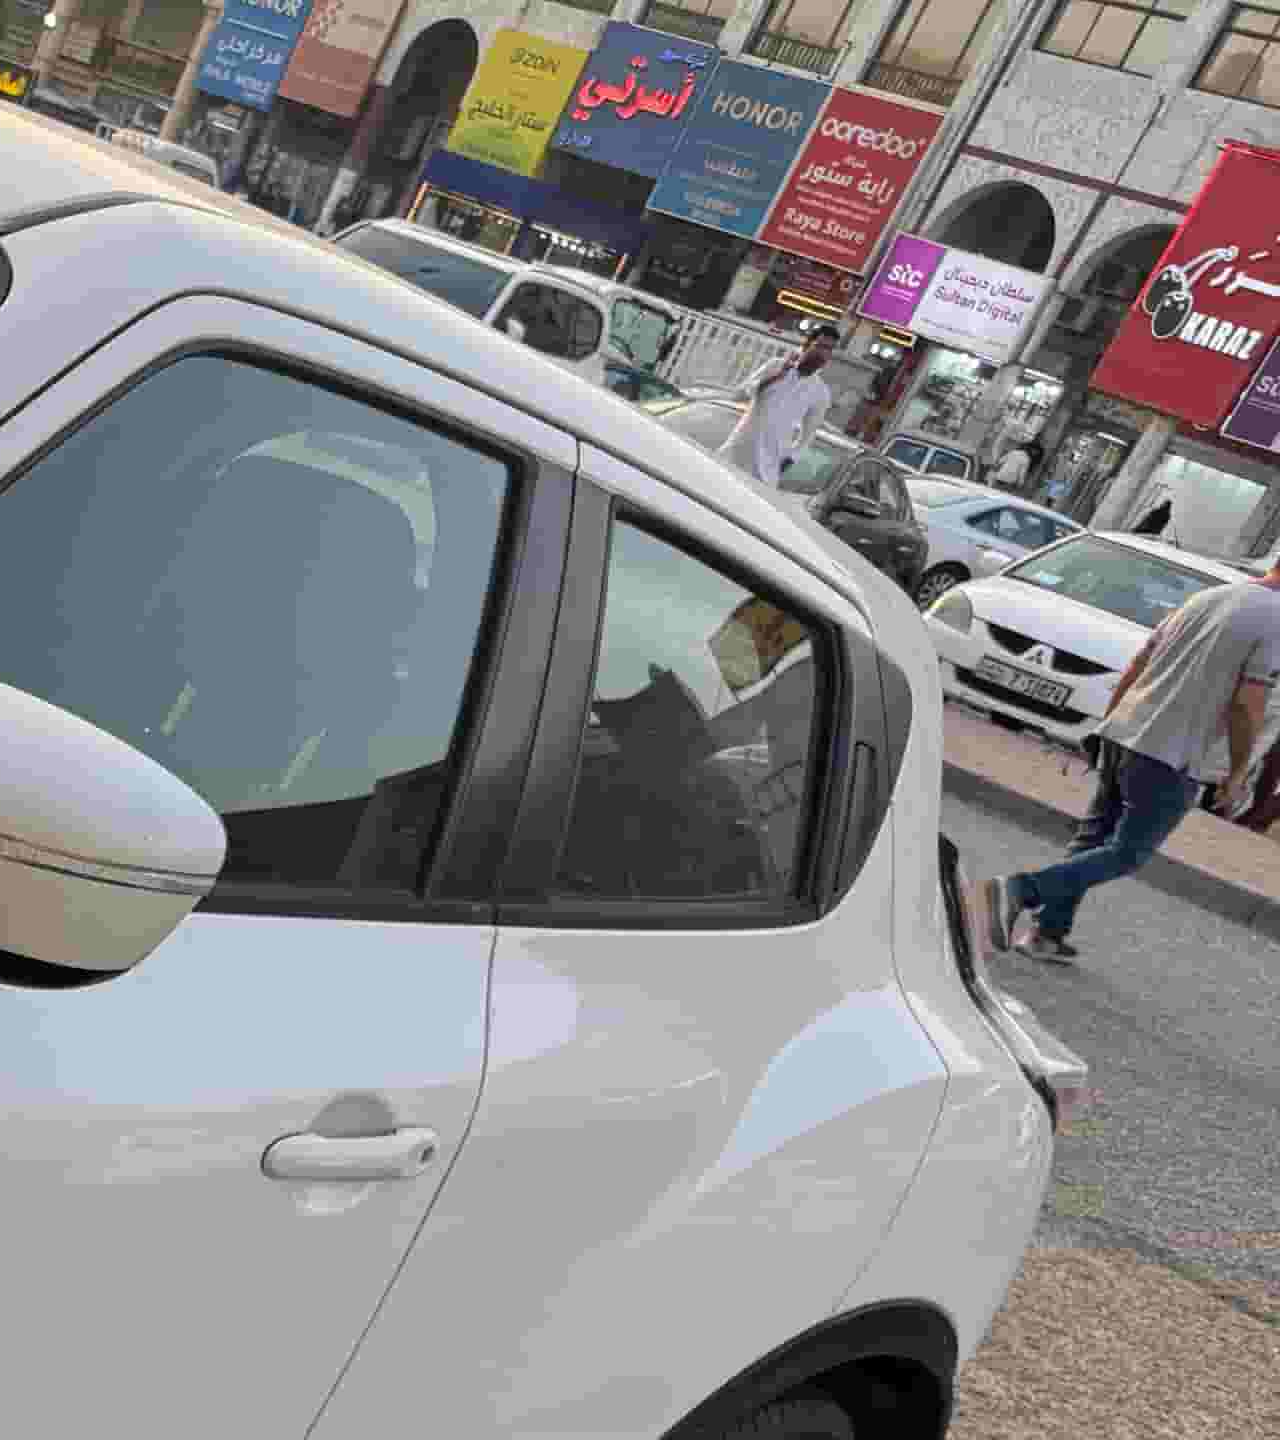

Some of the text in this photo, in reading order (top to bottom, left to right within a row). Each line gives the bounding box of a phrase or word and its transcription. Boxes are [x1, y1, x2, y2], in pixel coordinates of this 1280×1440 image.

[712, 91, 803, 136] HONOR
[820, 117, 917, 159] ooredoo
[800, 161, 854, 186] ستور
[784, 207, 823, 232] Raya
[822, 218, 866, 246] Store
[887, 263, 924, 288] stc
[935, 285, 977, 313] Sultan
[976, 296, 1025, 329] Digital
[1181, 312, 1263, 360] KARAZ
